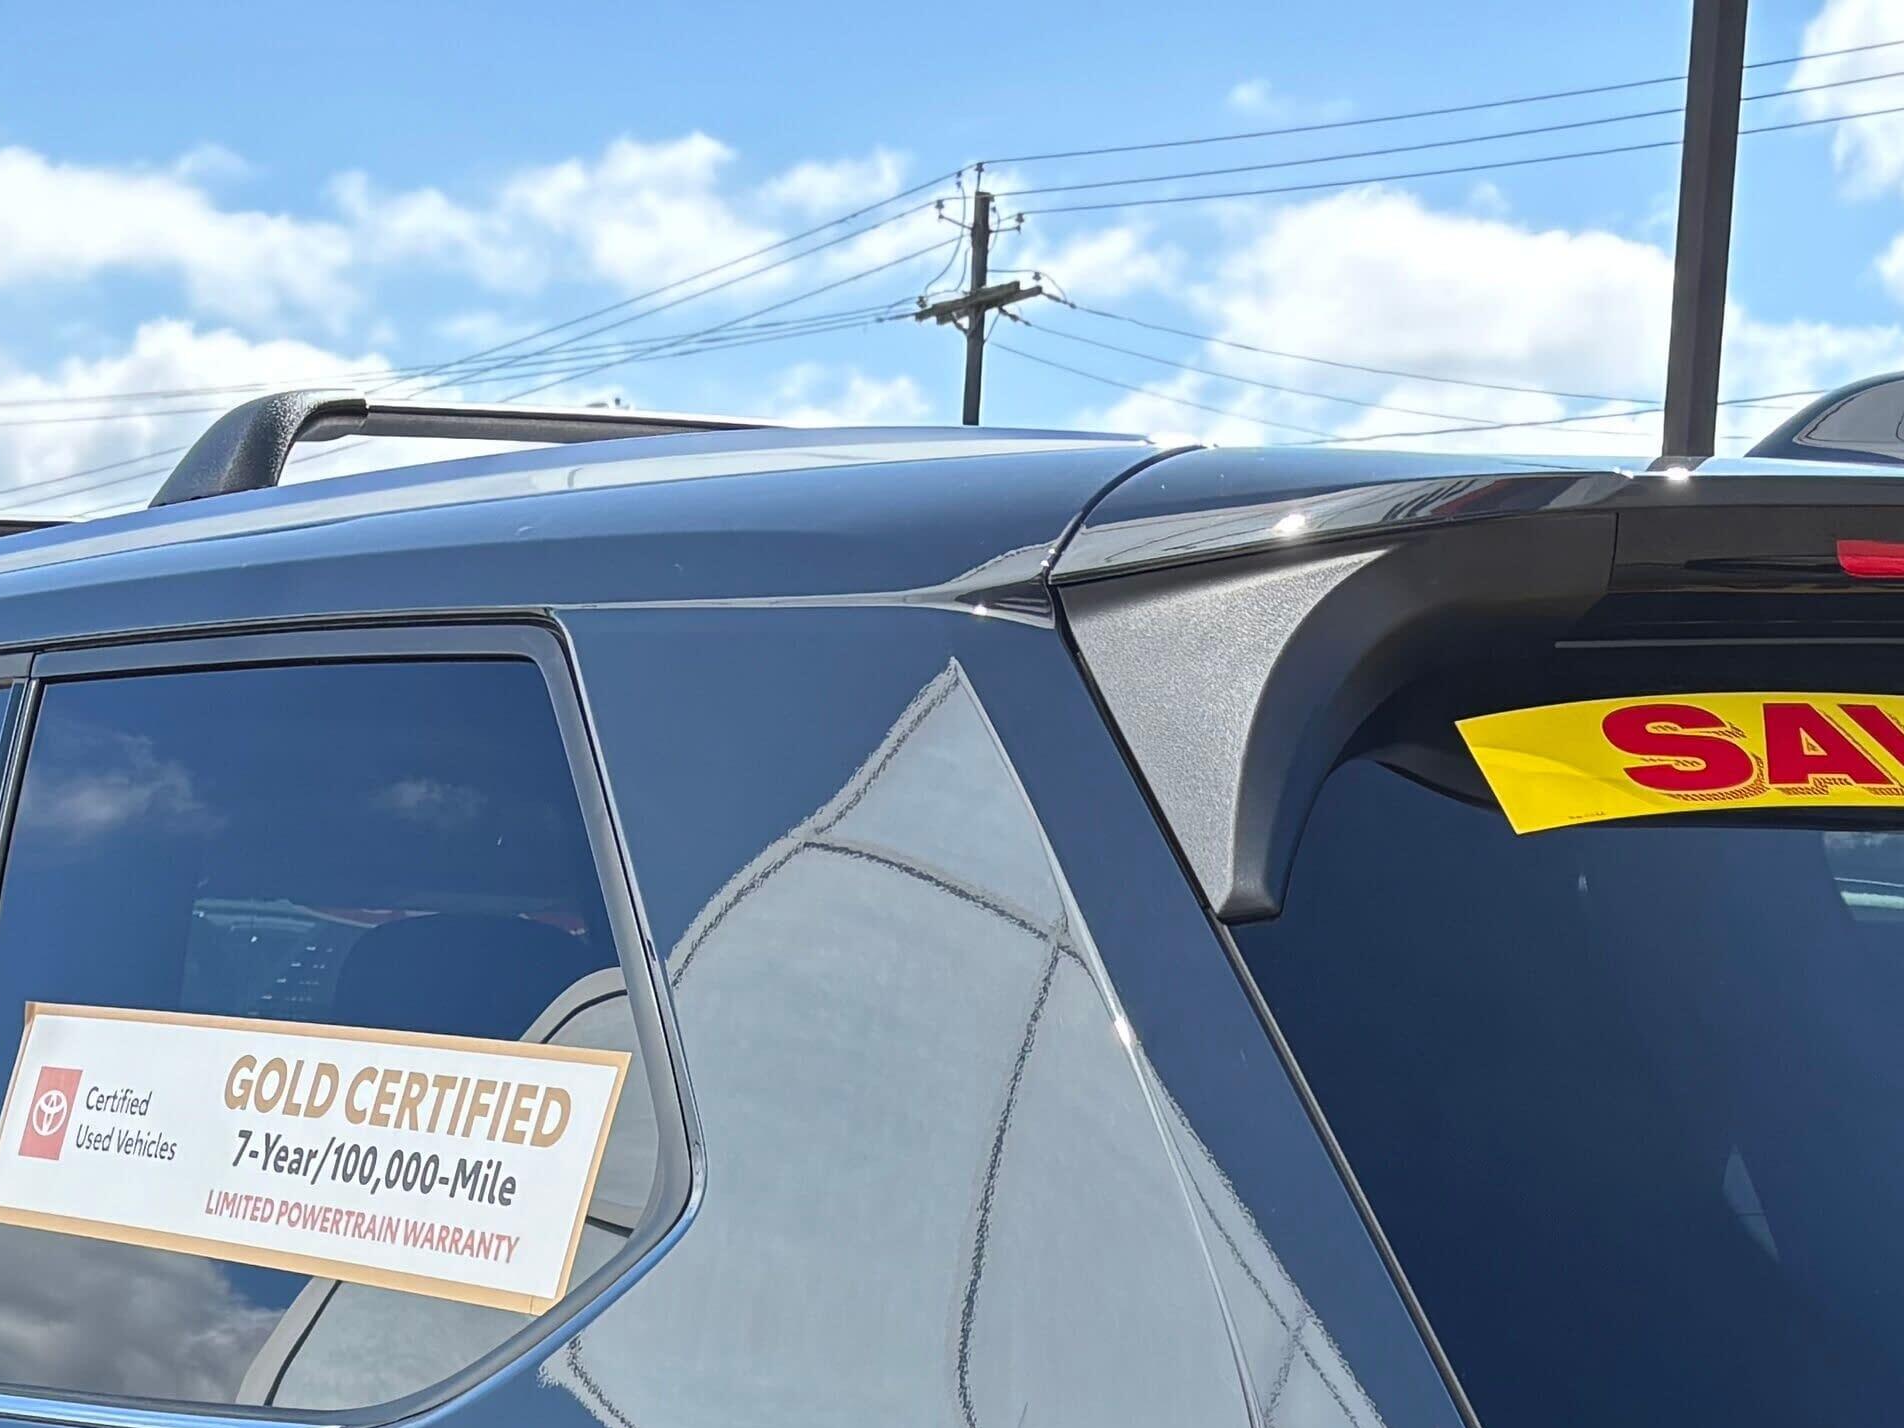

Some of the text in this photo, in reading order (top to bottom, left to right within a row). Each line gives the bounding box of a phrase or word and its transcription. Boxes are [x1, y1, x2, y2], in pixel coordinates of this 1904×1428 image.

[85, 1086, 153, 1116] Certified
[223, 1054, 572, 1149] GOLD CERTIFIED
[75, 1123, 178, 1161] Used Vehicles
[231, 1129, 518, 1207] 7-Year/100,000-Mile
[204, 1189, 520, 1265] LIMITED POWERTRAIN WARRANTY
